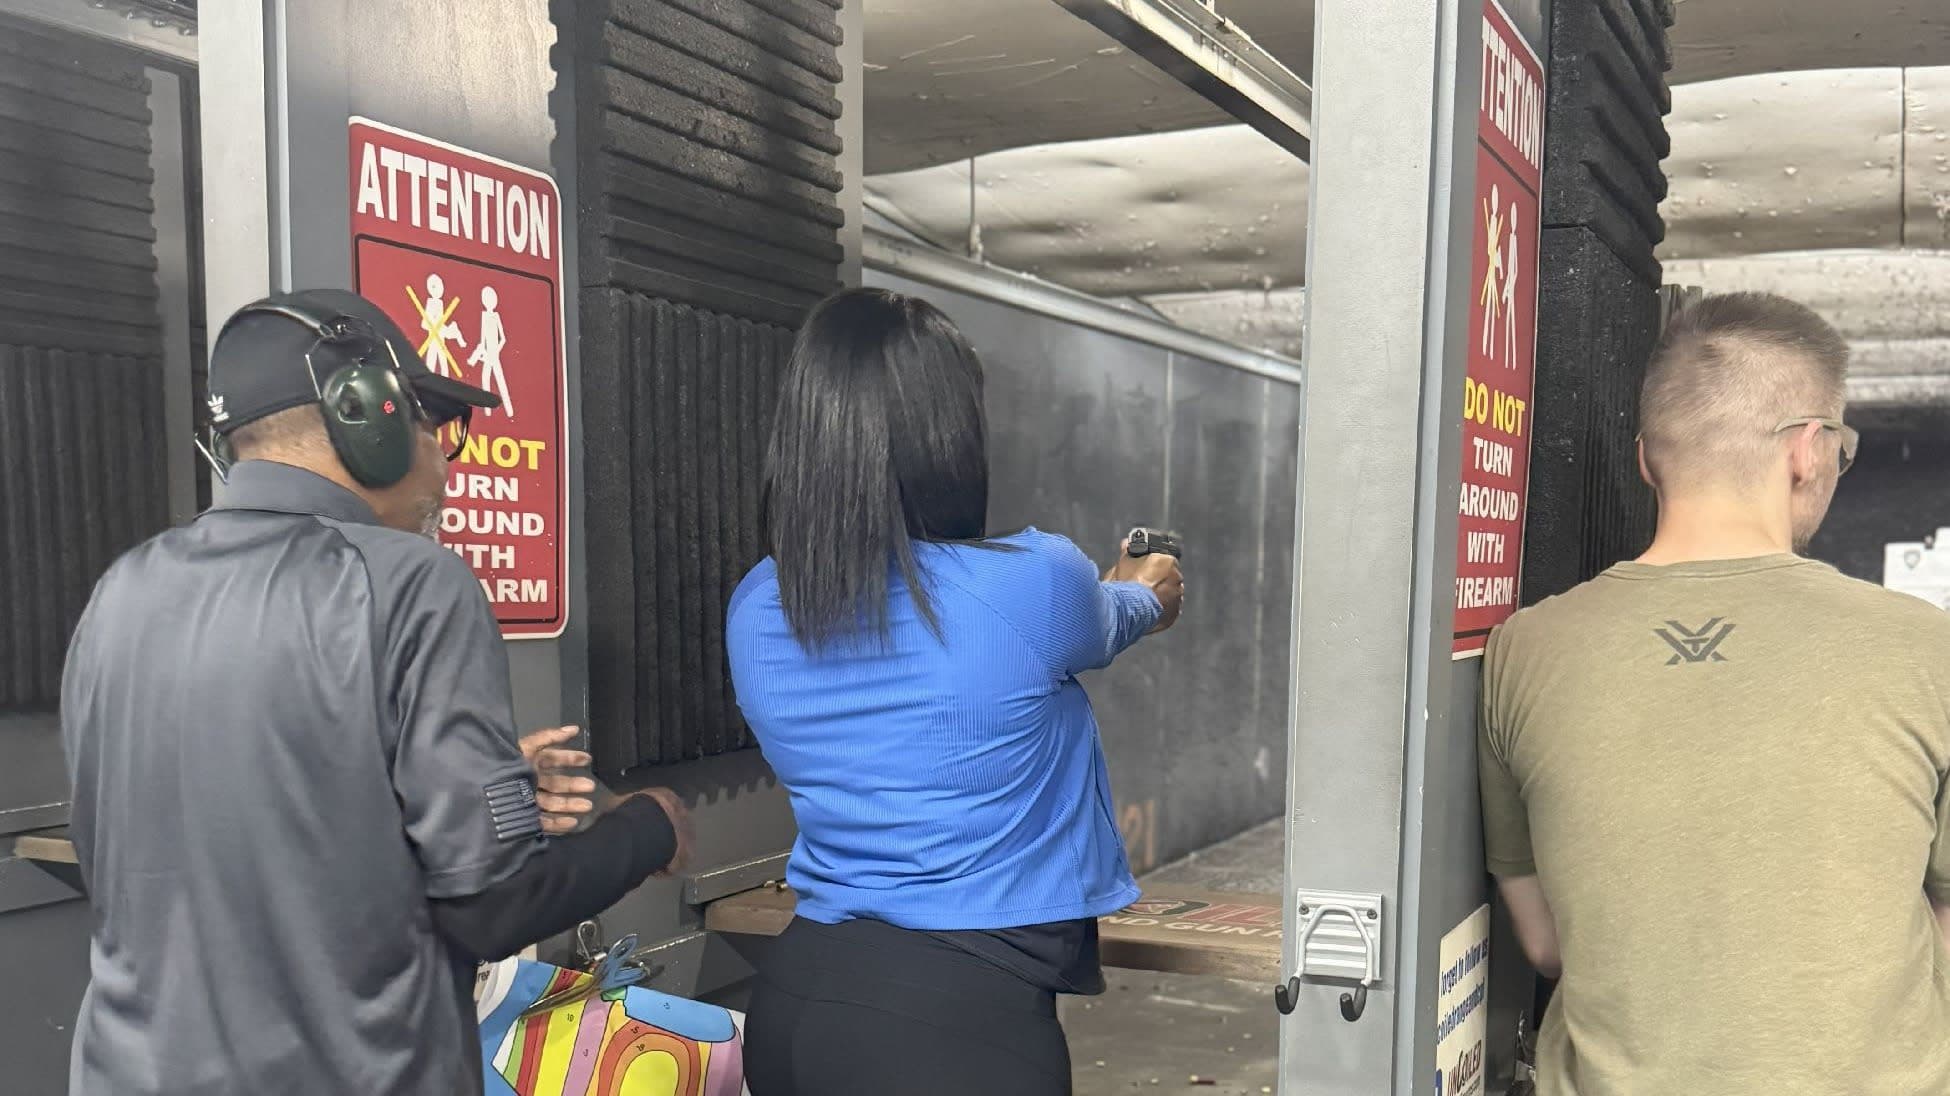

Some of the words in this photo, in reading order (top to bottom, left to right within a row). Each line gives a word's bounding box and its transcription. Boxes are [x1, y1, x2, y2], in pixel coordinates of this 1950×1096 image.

[1480, 15, 1541, 171] TTENTION
[356, 141, 551, 260] ATTENTION
[1463, 376, 1489, 425] DO
[1493, 389, 1526, 437] NOT
[460, 434, 546, 471] NOT
[1473, 436, 1513, 478] TURN
[445, 472, 519, 502] URN
[1458, 482, 1519, 521] AROUND
[440, 507, 545, 537] OUND
[1467, 531, 1505, 564] WITH
[1098, 915, 1159, 926] ND
[1164, 922, 1262, 935] GUN
